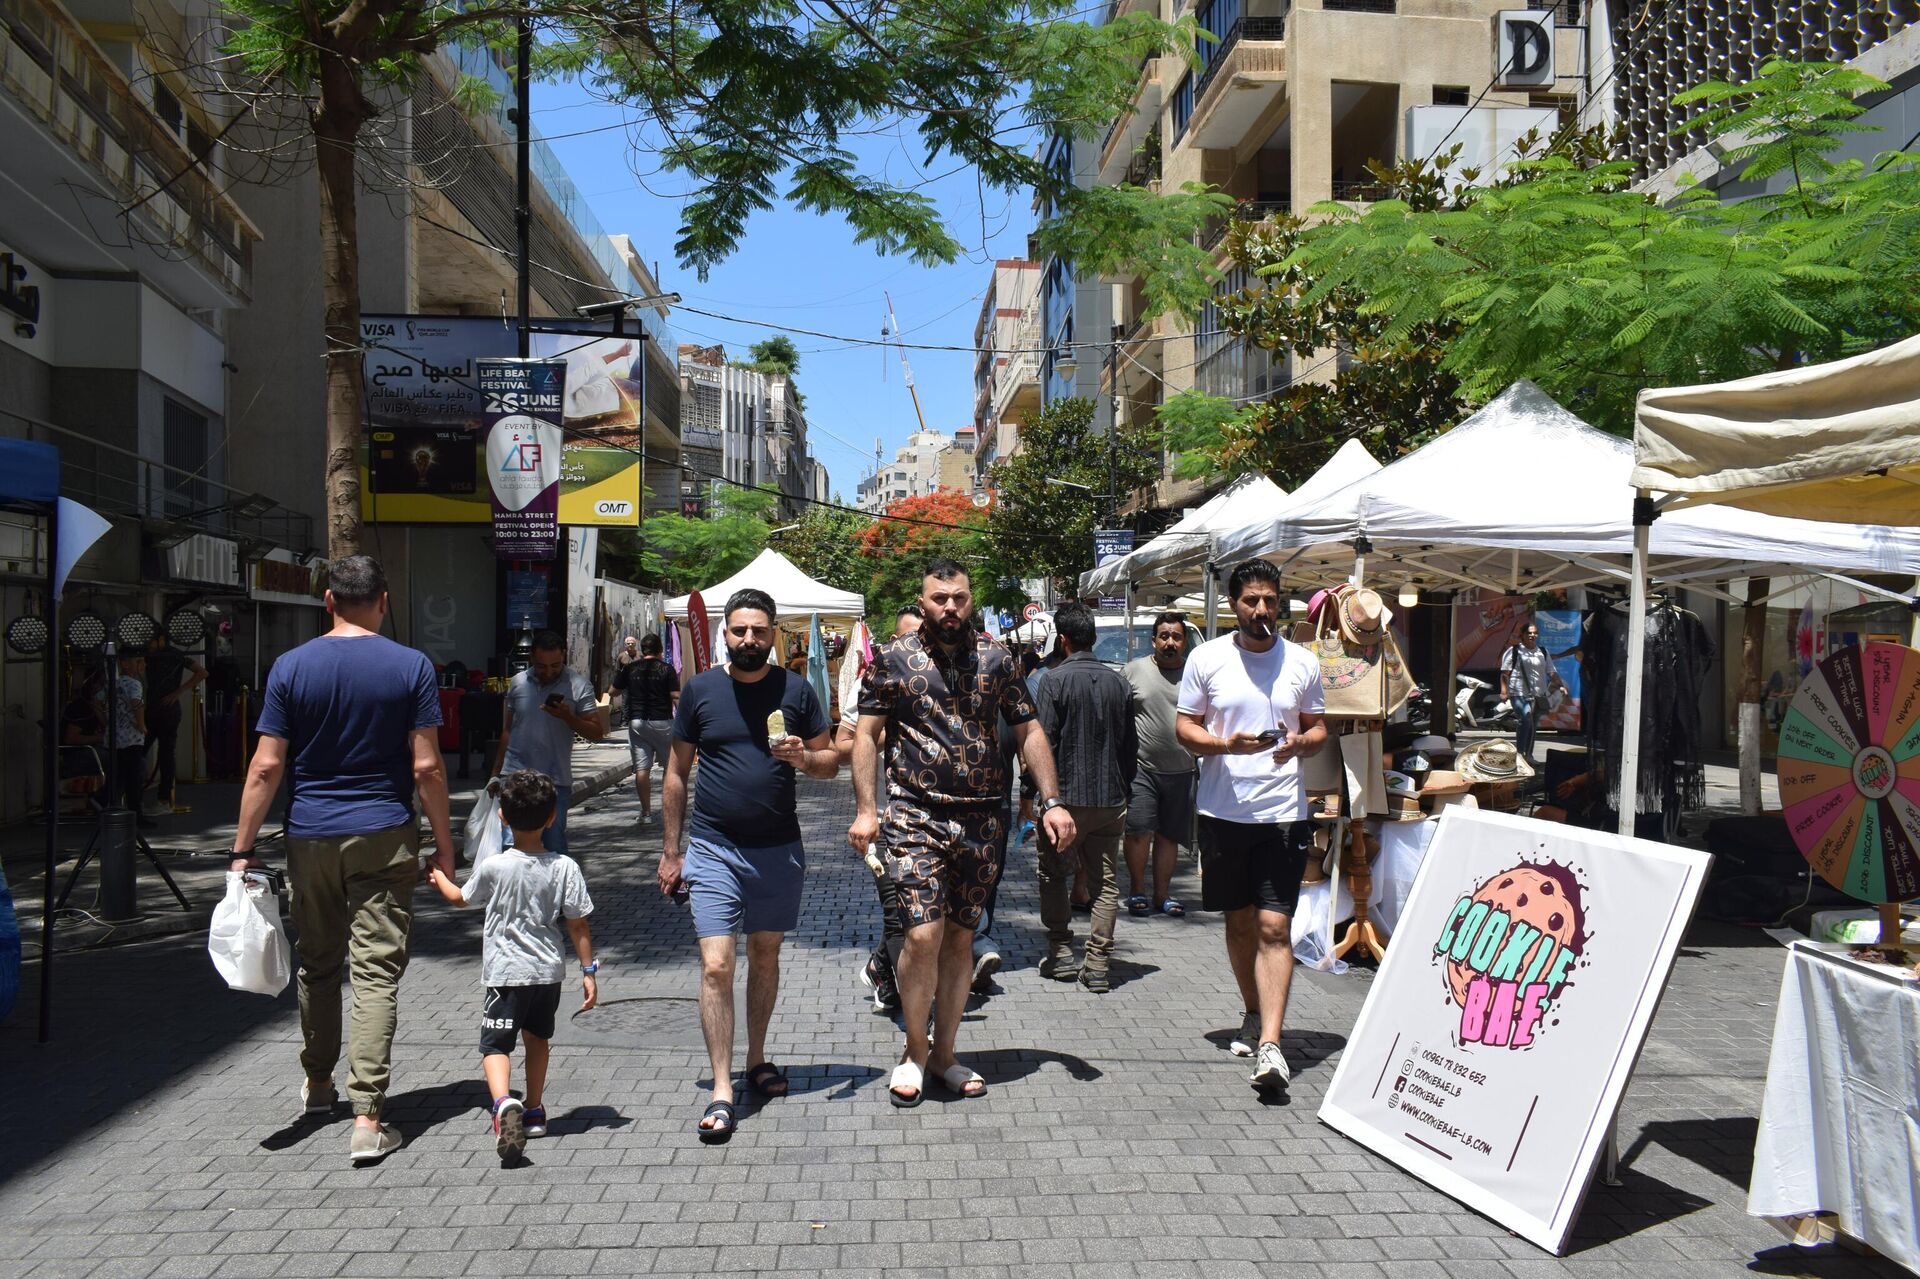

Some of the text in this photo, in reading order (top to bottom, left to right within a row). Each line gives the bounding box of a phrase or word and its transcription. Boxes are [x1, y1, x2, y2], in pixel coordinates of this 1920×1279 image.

[1505, 19, 1551, 75] D
[362, 323, 396, 337] VISA
[372, 364, 413, 386] صح
[480, 369, 532, 378] LIFE BEAT
[480, 381, 532, 390] FESTIVAL
[485, 392, 561, 413] 26 JUNE
[598, 502, 628, 514] OMT
[172, 540, 240, 586] WHITE
[1097, 544, 1114, 554] 26
[1841, 654, 1865, 721] BETTER LUCK
[1827, 714, 1856, 751] COOKIES
[1862, 813, 1875, 866] DISCOUNT
[1433, 895, 1577, 1014] COOKIE
[483, 1017, 514, 1029] RSE
[1459, 976, 1551, 1050] BAE
[1421, 1049, 1445, 1067] 00961
[1452, 1062, 1470, 1078] 832
[1468, 1071, 1487, 1086] 652
